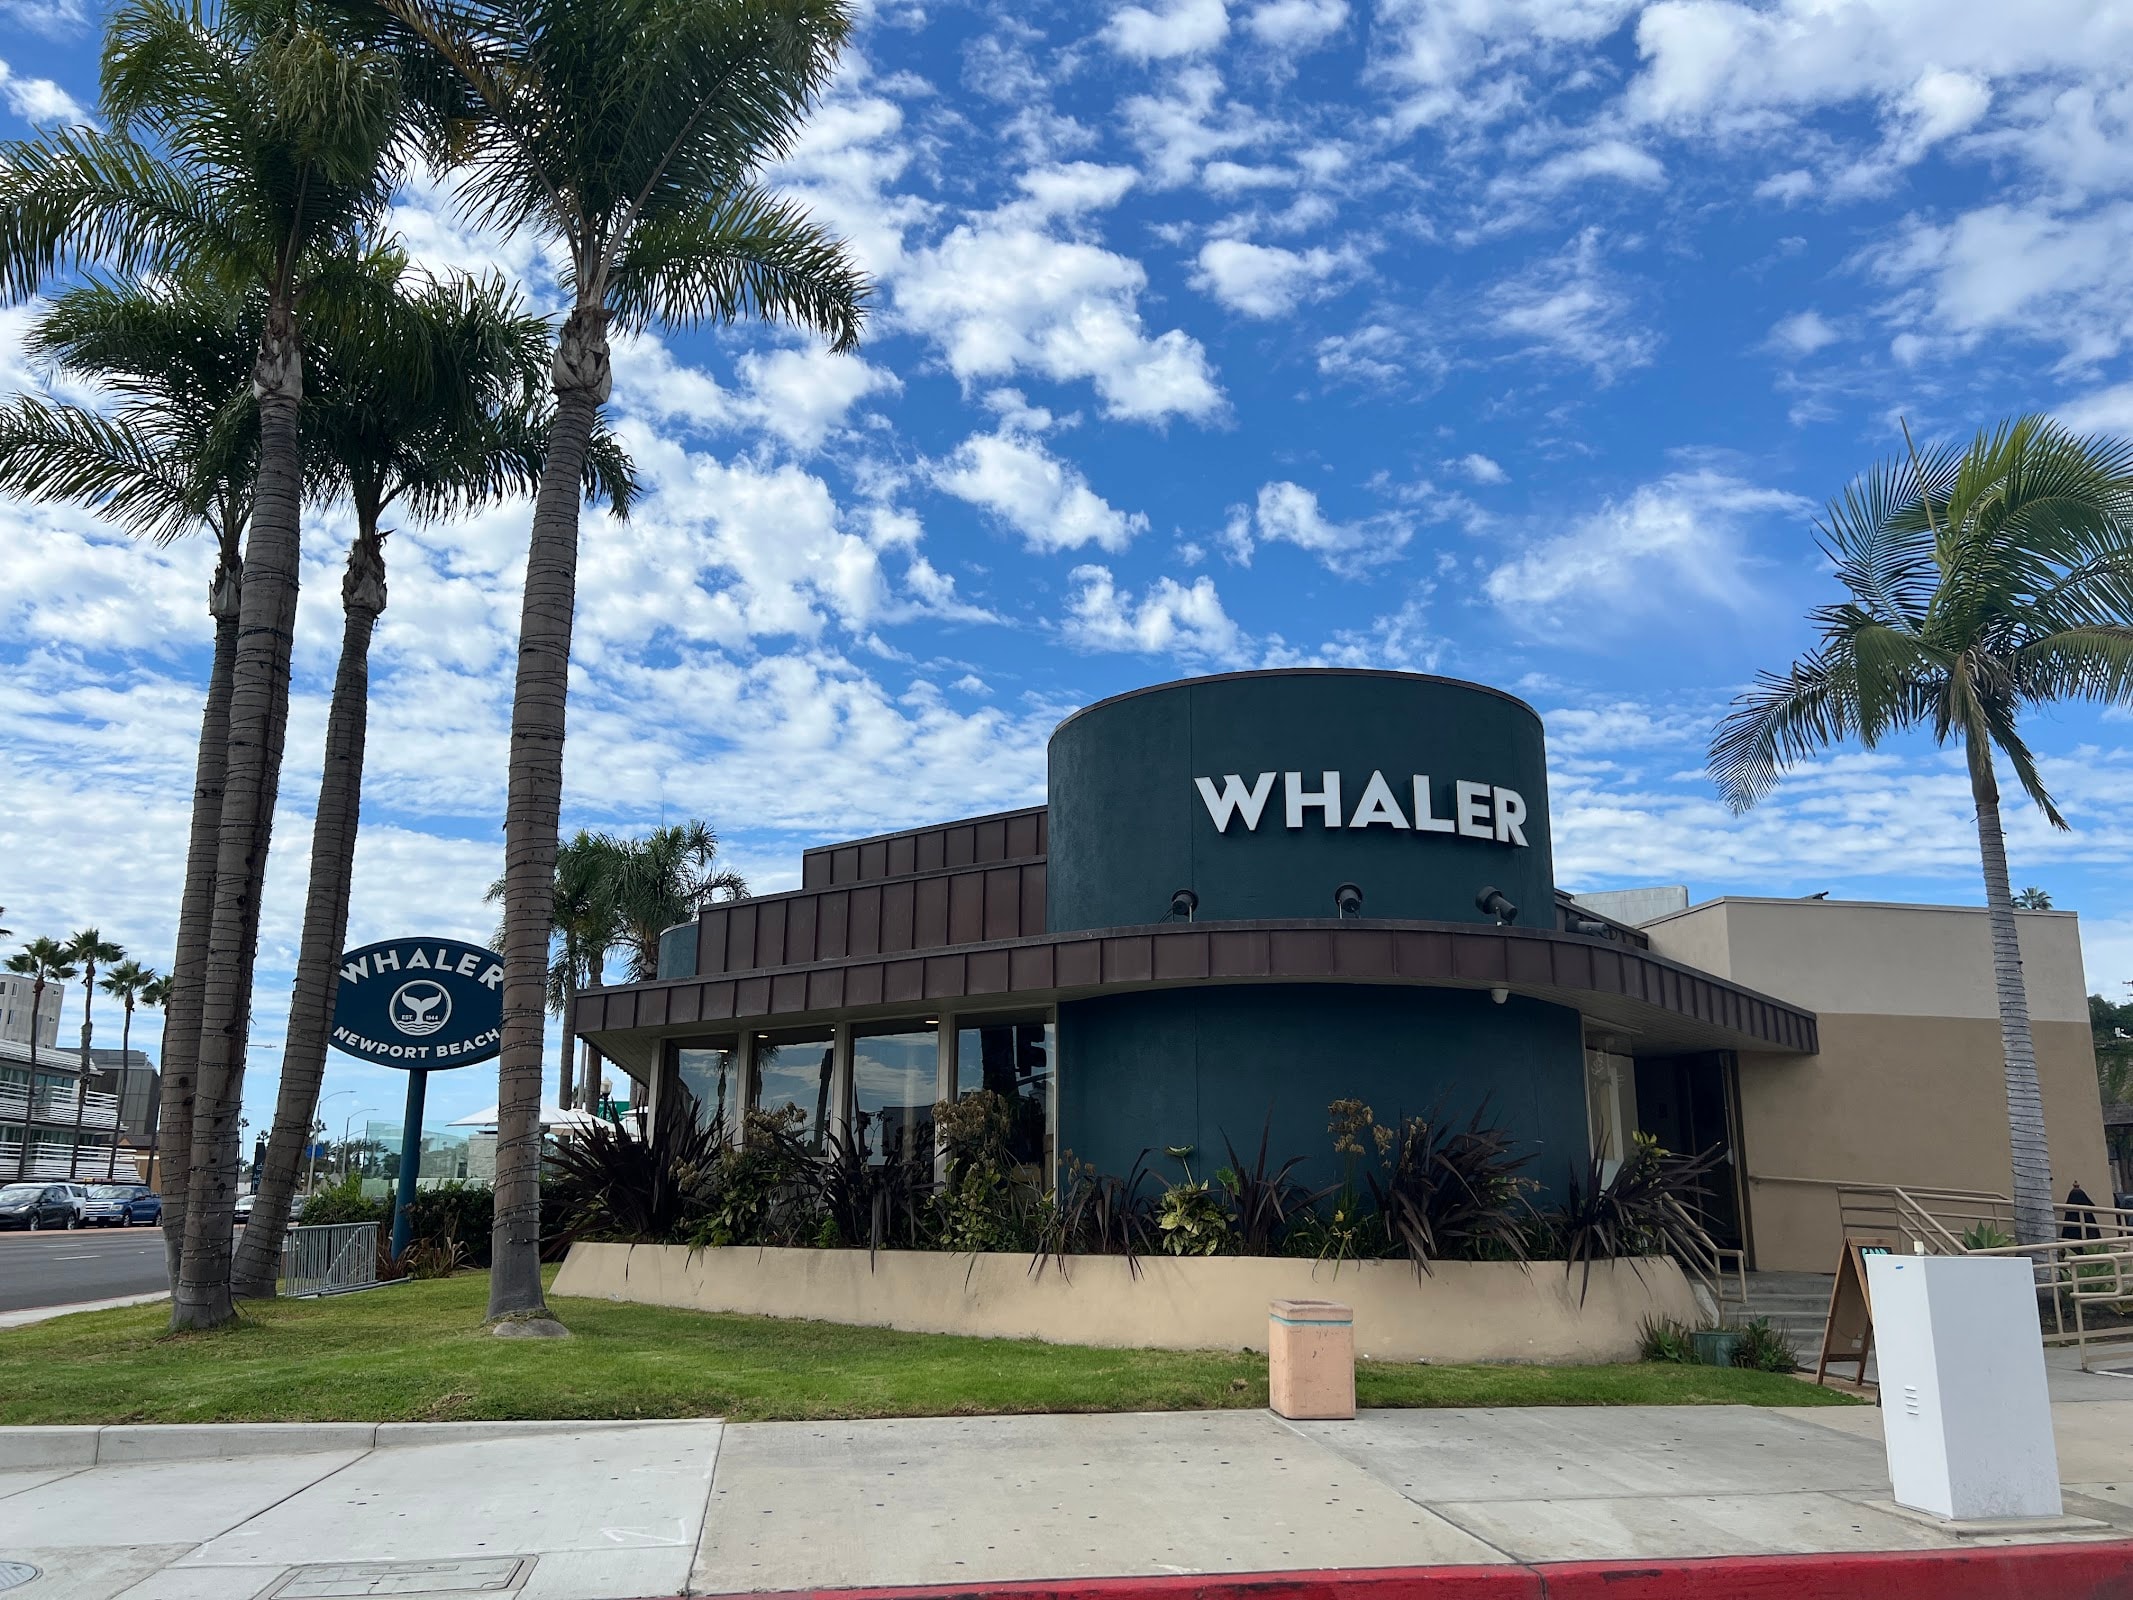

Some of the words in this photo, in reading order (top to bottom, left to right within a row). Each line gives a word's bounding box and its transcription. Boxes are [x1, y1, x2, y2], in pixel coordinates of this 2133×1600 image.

[1193, 769, 1530, 848] WHALER
[339, 947, 504, 991] WHALER
[333, 1026, 430, 1059] NEWPORT
[436, 1028, 501, 1059] BEACH
